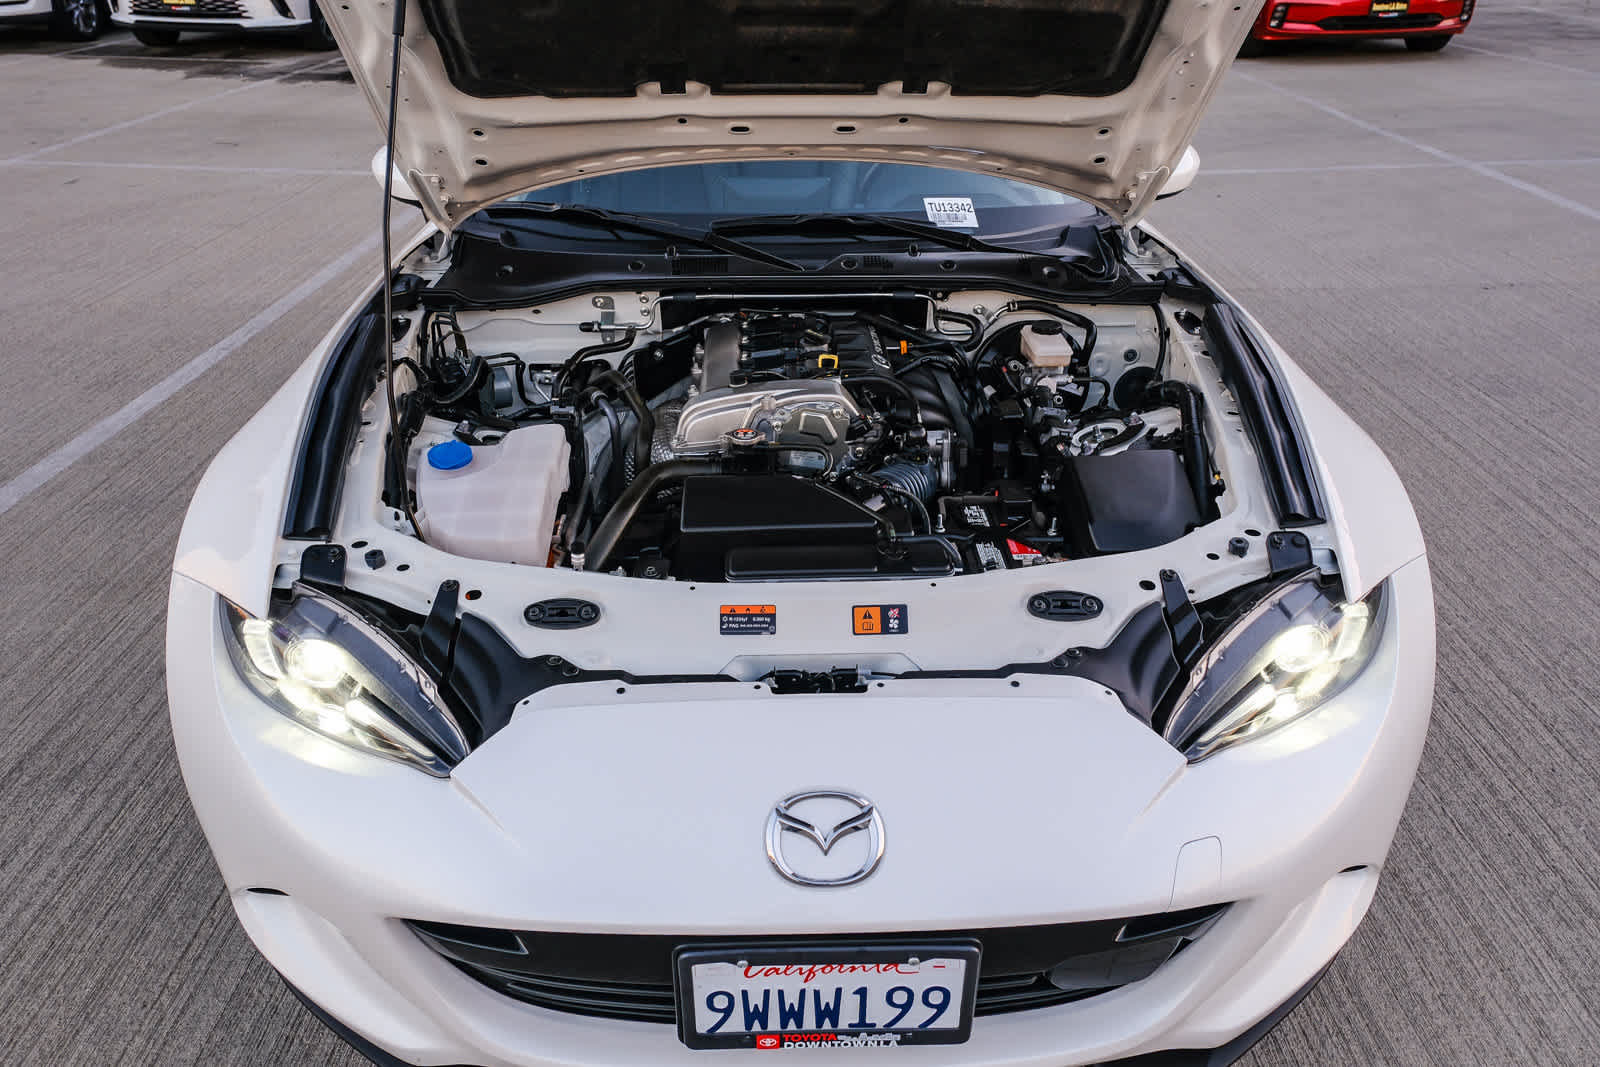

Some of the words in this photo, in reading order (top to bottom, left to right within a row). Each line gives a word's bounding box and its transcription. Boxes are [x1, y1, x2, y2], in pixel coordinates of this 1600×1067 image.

[928, 202, 974, 212] TU13342
[744, 964, 919, 983] California
[705, 986, 951, 1034] 9WWW199
[783, 1033, 837, 1042] TOYOTA
